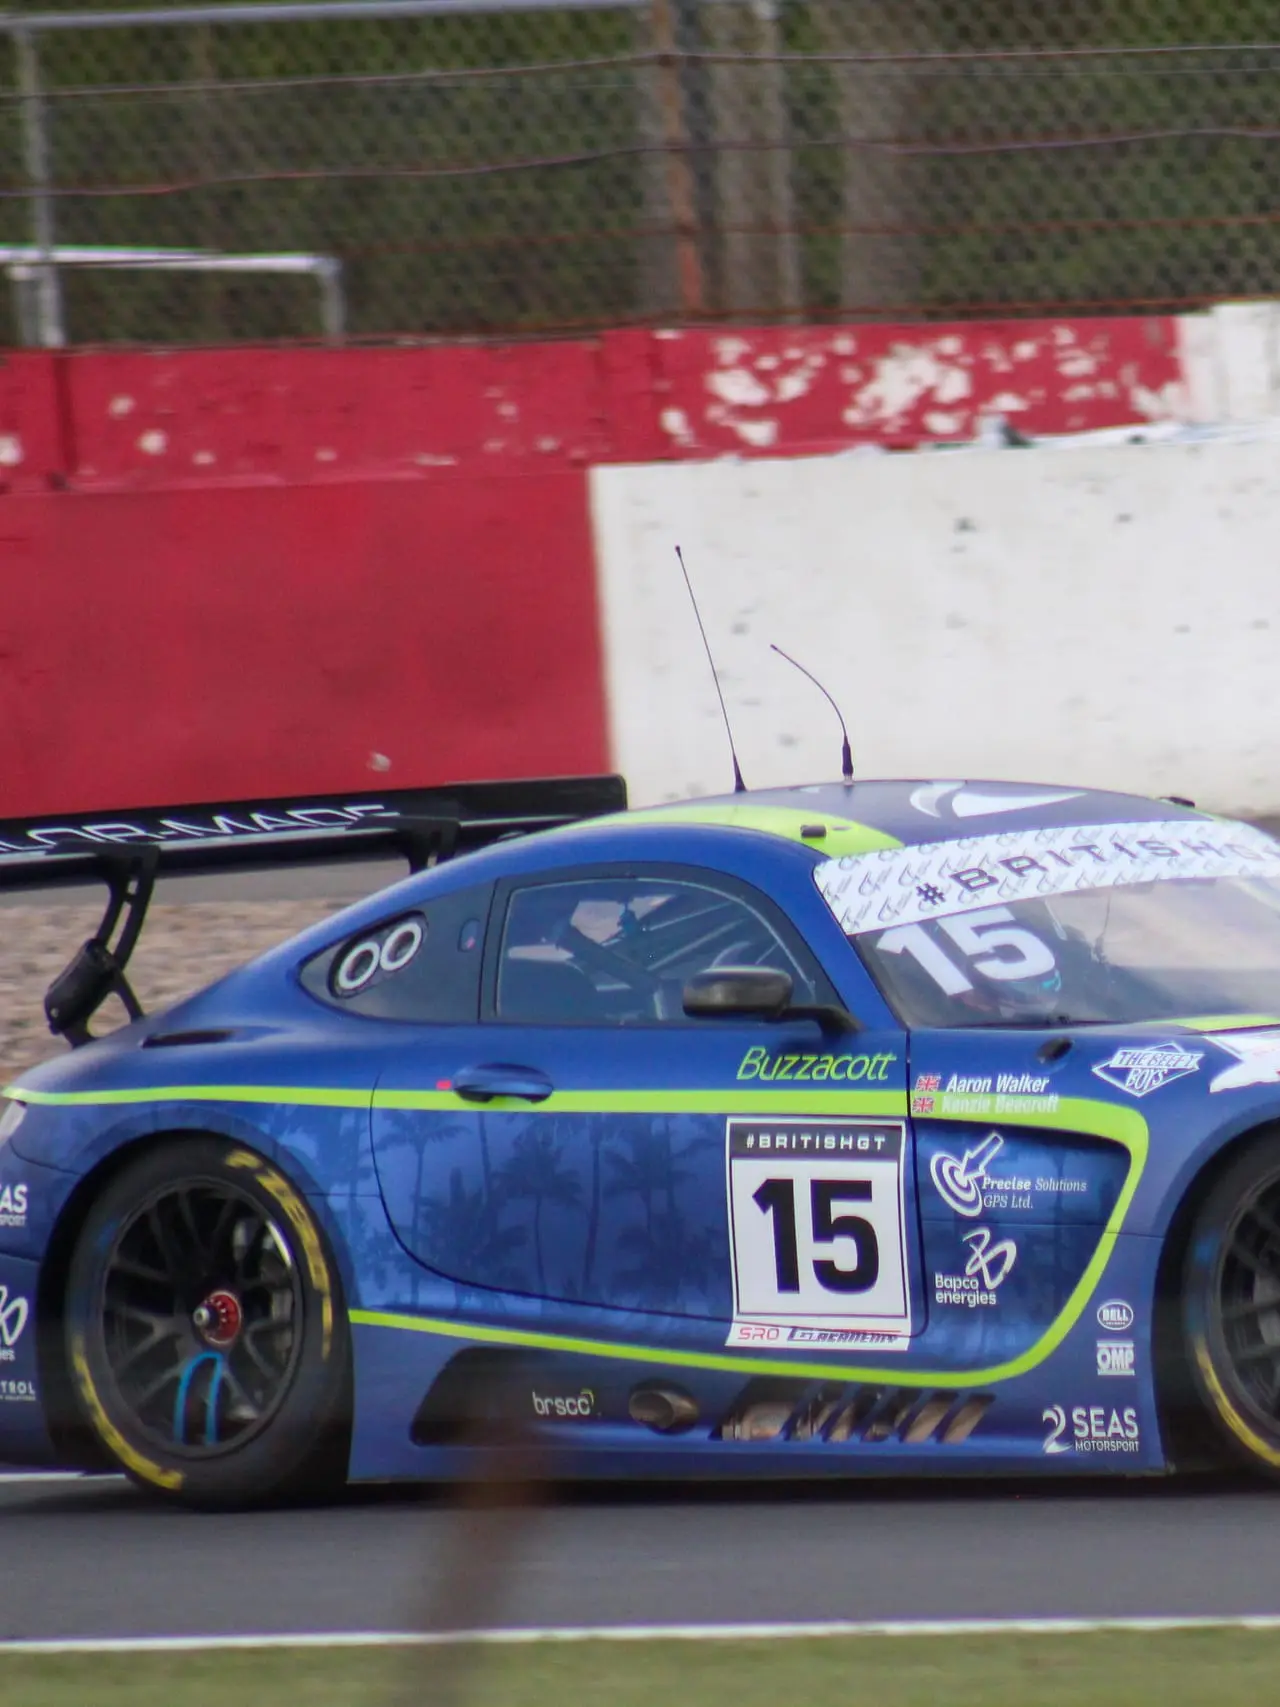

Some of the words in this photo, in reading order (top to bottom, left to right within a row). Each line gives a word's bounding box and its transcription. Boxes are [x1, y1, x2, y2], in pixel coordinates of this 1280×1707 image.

[876, 905, 1057, 998] 15
[736, 1045, 897, 1081] Buzzacott
[946, 1073, 991, 1093] Aaron
[996, 1074, 1050, 1093] Walker
[746, 1133, 886, 1150] #BRITISHGT
[982, 1176, 1031, 1191] Precise
[1035, 1177, 1087, 1192] Solutions
[983, 1194, 1008, 1208] GPS
[1011, 1193, 1033, 1209] Ltd.
[752, 1178, 880, 1295] 15
[935, 1272, 979, 1292] Bapco
[936, 1290, 996, 1307] energies
[738, 1327, 779, 1341] SRO
[1097, 1348, 1134, 1371] OMP
[532, 1389, 592, 1416] brscc
[1072, 1406, 1139, 1438] SEAS
[1075, 1439, 1139, 1452] MOTORSPORT
